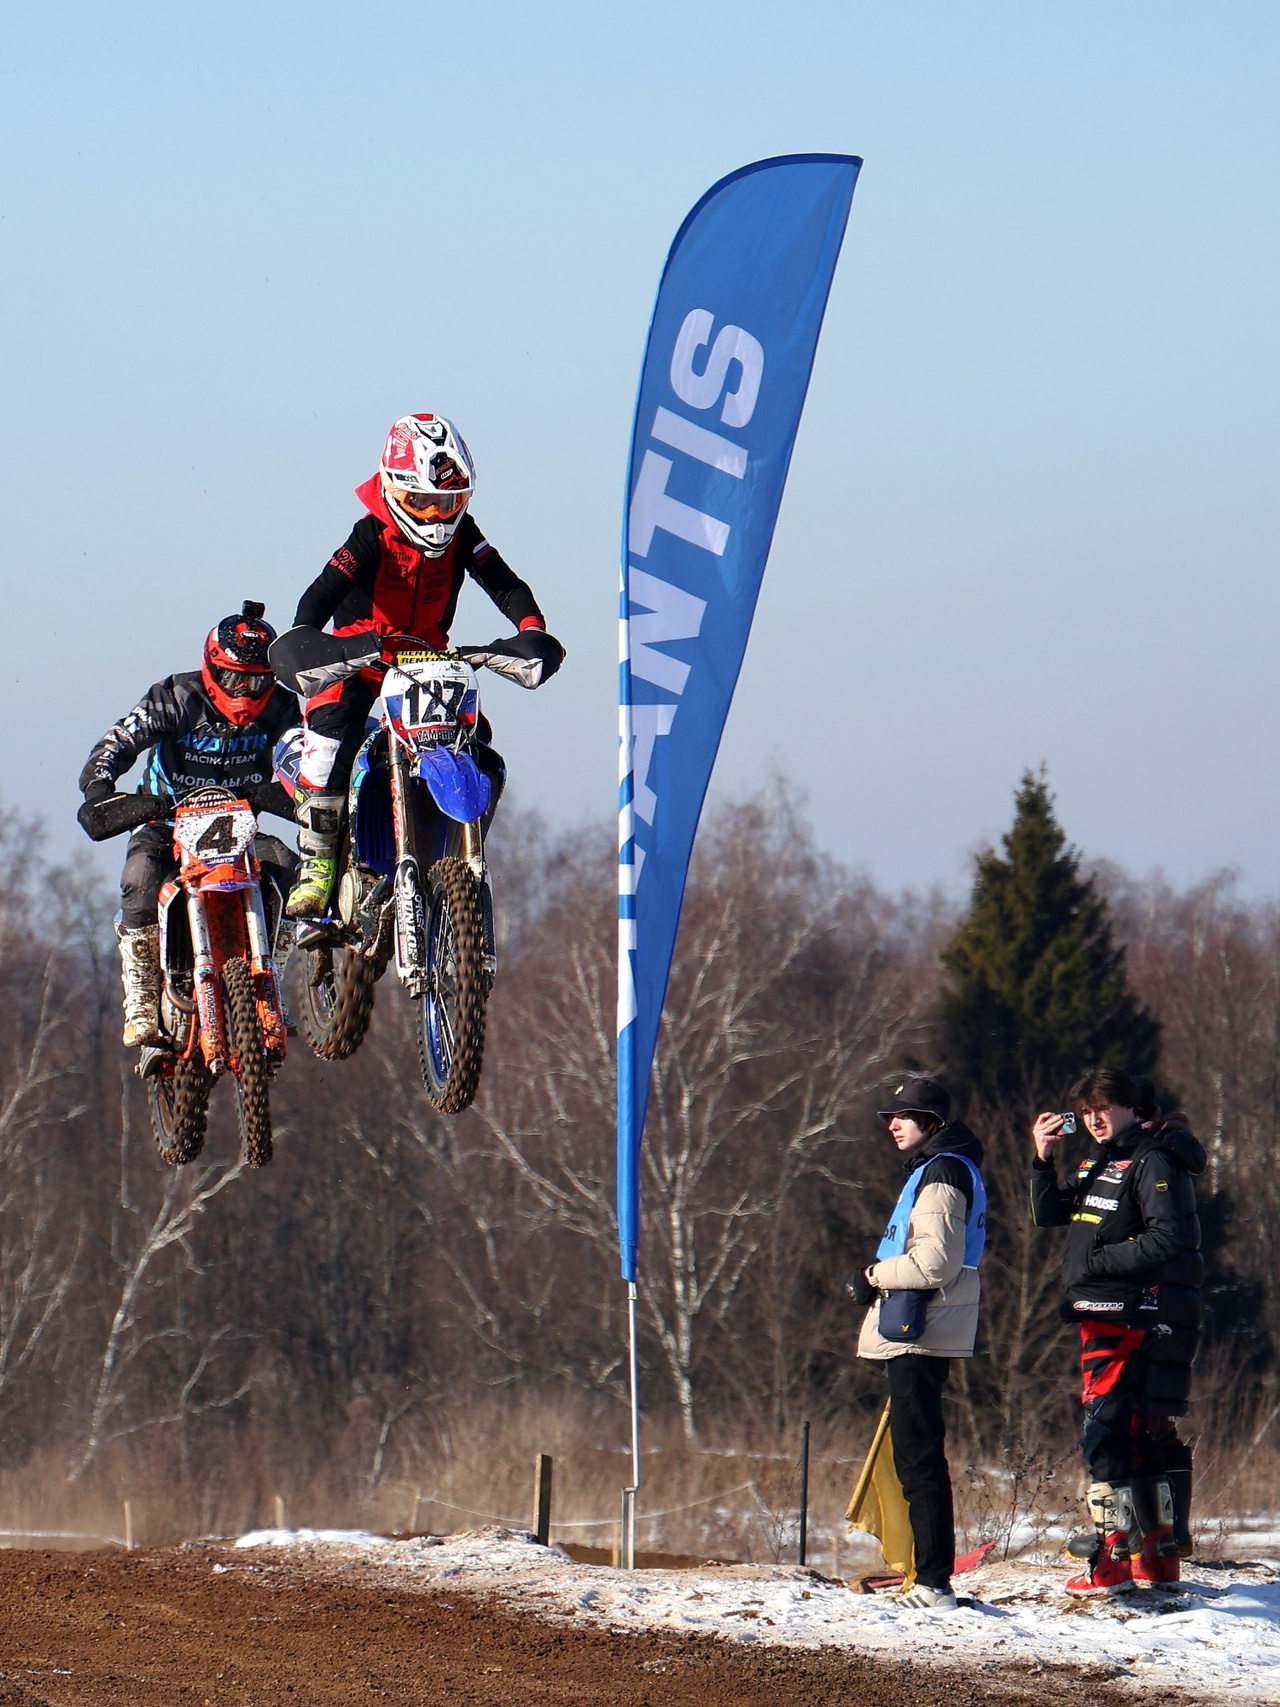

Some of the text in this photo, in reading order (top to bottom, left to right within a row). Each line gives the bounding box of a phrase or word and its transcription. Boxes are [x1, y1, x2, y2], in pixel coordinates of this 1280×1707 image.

[405, 679, 467, 726] 127
[417, 728, 456, 742] YAMAHA
[231, 753, 257, 764] TEAM
[196, 815, 238, 854] 4
[414, 894, 425, 931] OAKLEY
[1085, 1194, 1120, 1212] HOUSE
